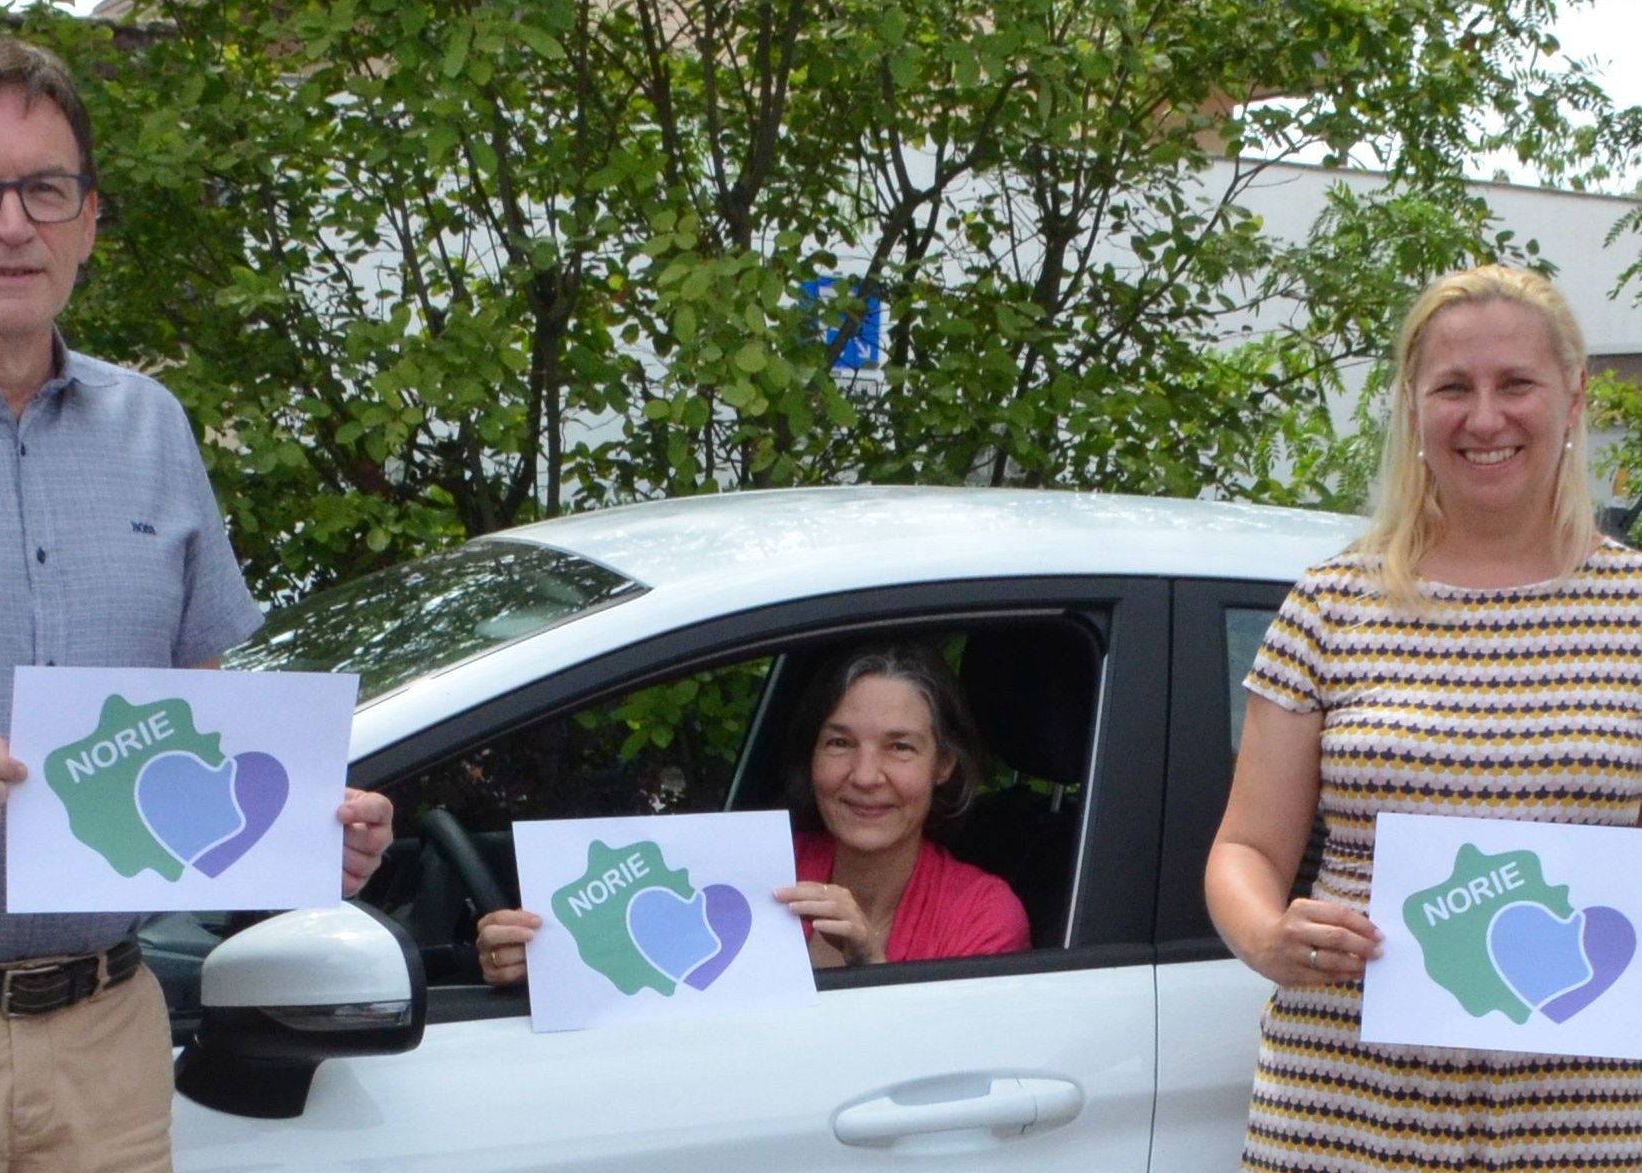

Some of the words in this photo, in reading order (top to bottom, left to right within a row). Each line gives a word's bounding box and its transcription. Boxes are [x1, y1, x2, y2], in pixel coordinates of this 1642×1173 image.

[65, 710, 175, 783] NORIE
[567, 852, 650, 918] NORIE
[1422, 861, 1525, 927] NORIE
